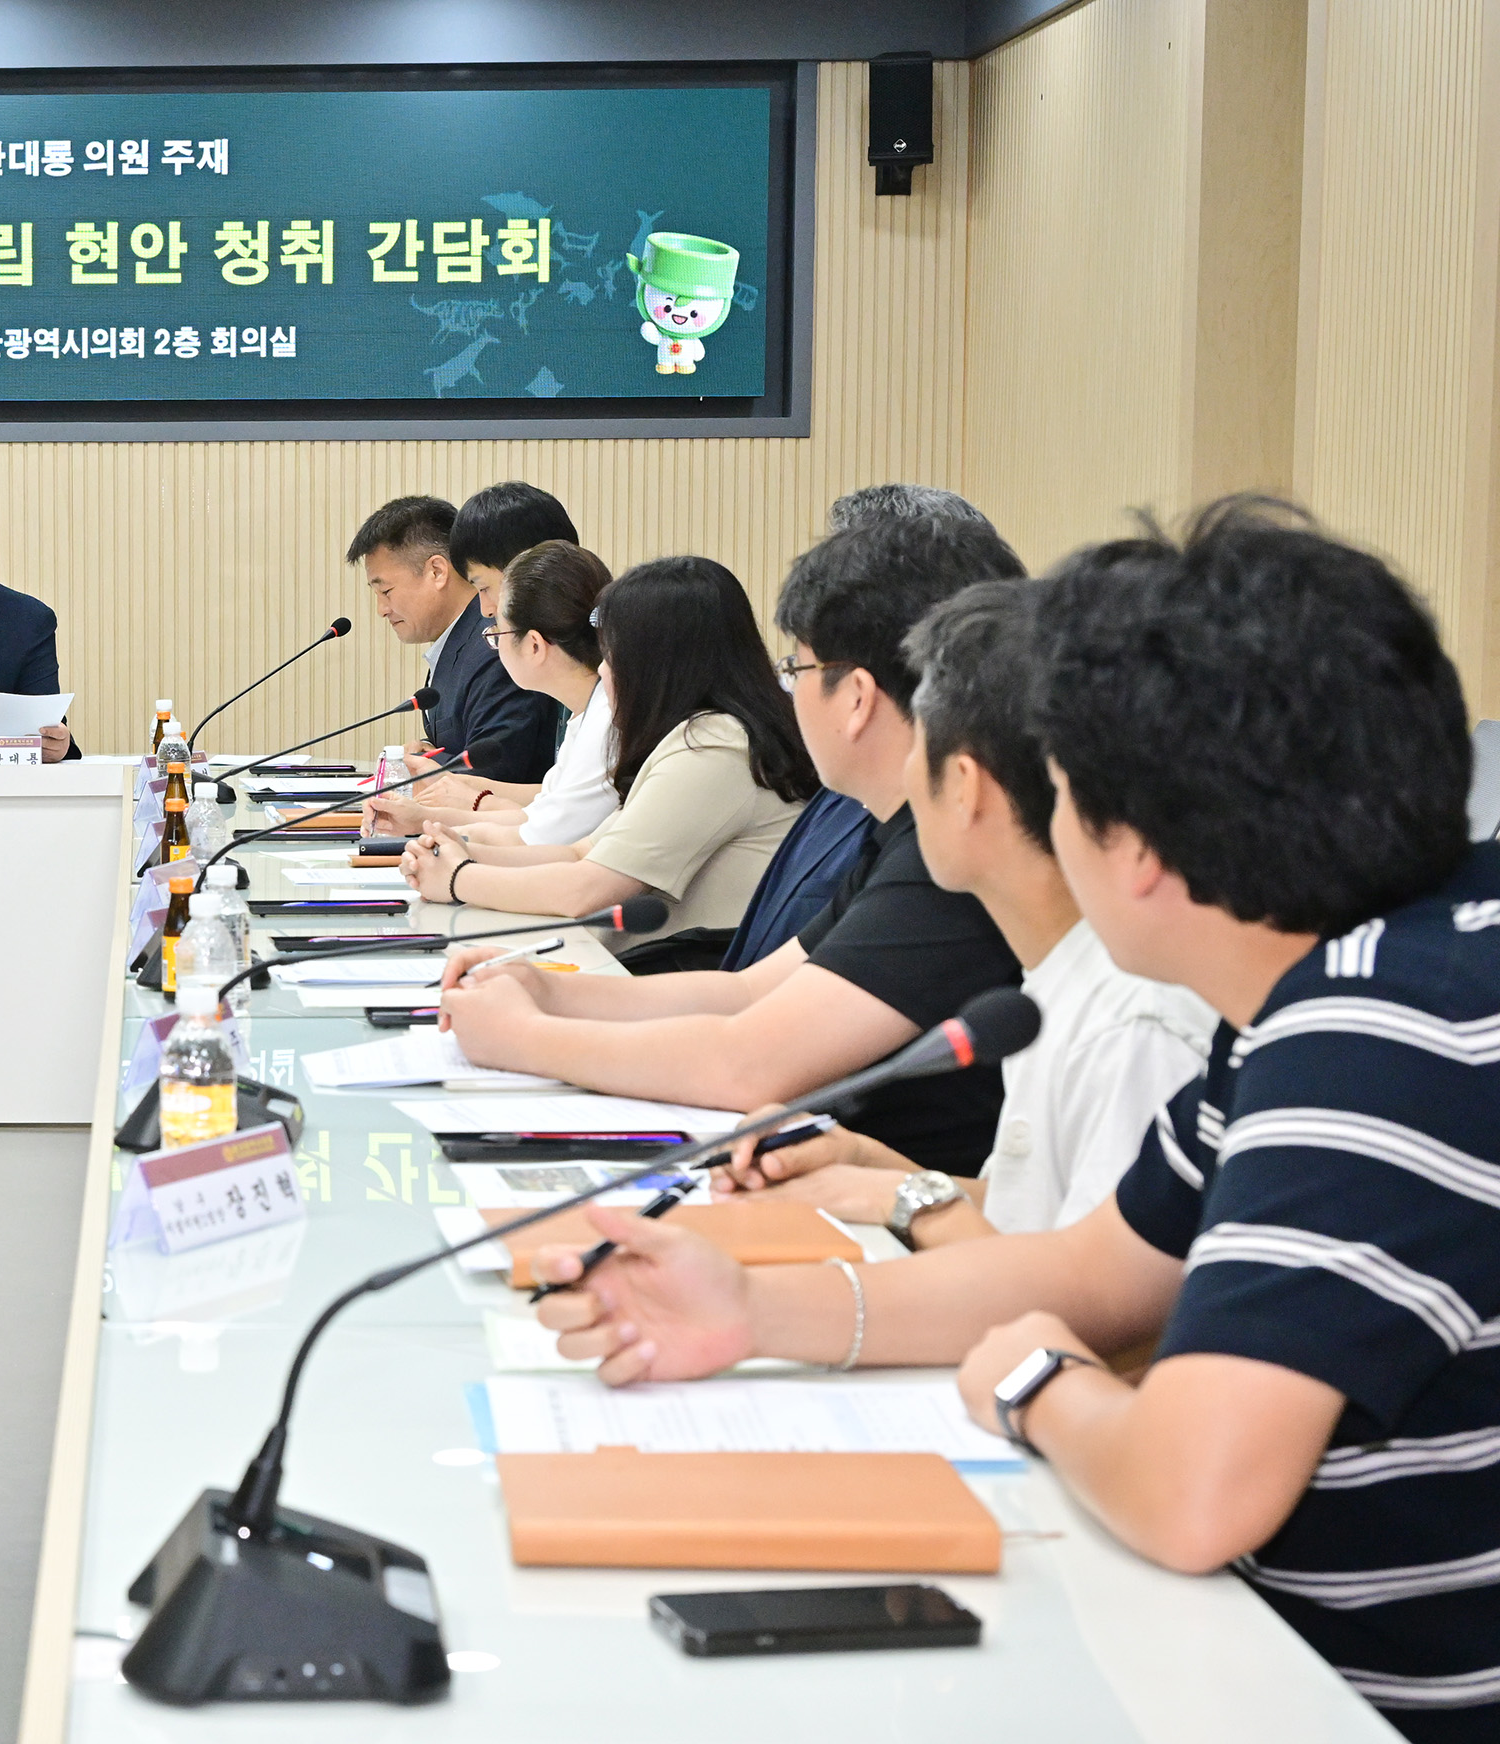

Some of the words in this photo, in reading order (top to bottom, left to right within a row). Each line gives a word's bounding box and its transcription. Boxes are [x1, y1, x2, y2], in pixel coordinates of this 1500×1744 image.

[84, 139, 150, 177] 의원
[162, 139, 230, 177] 주재
[67, 221, 189, 286] 현안
[215, 220, 335, 287] 청취
[368, 218, 553, 285] 간담회
[154, 327, 202, 359] 2층
[211, 326, 297, 359] 회의실
